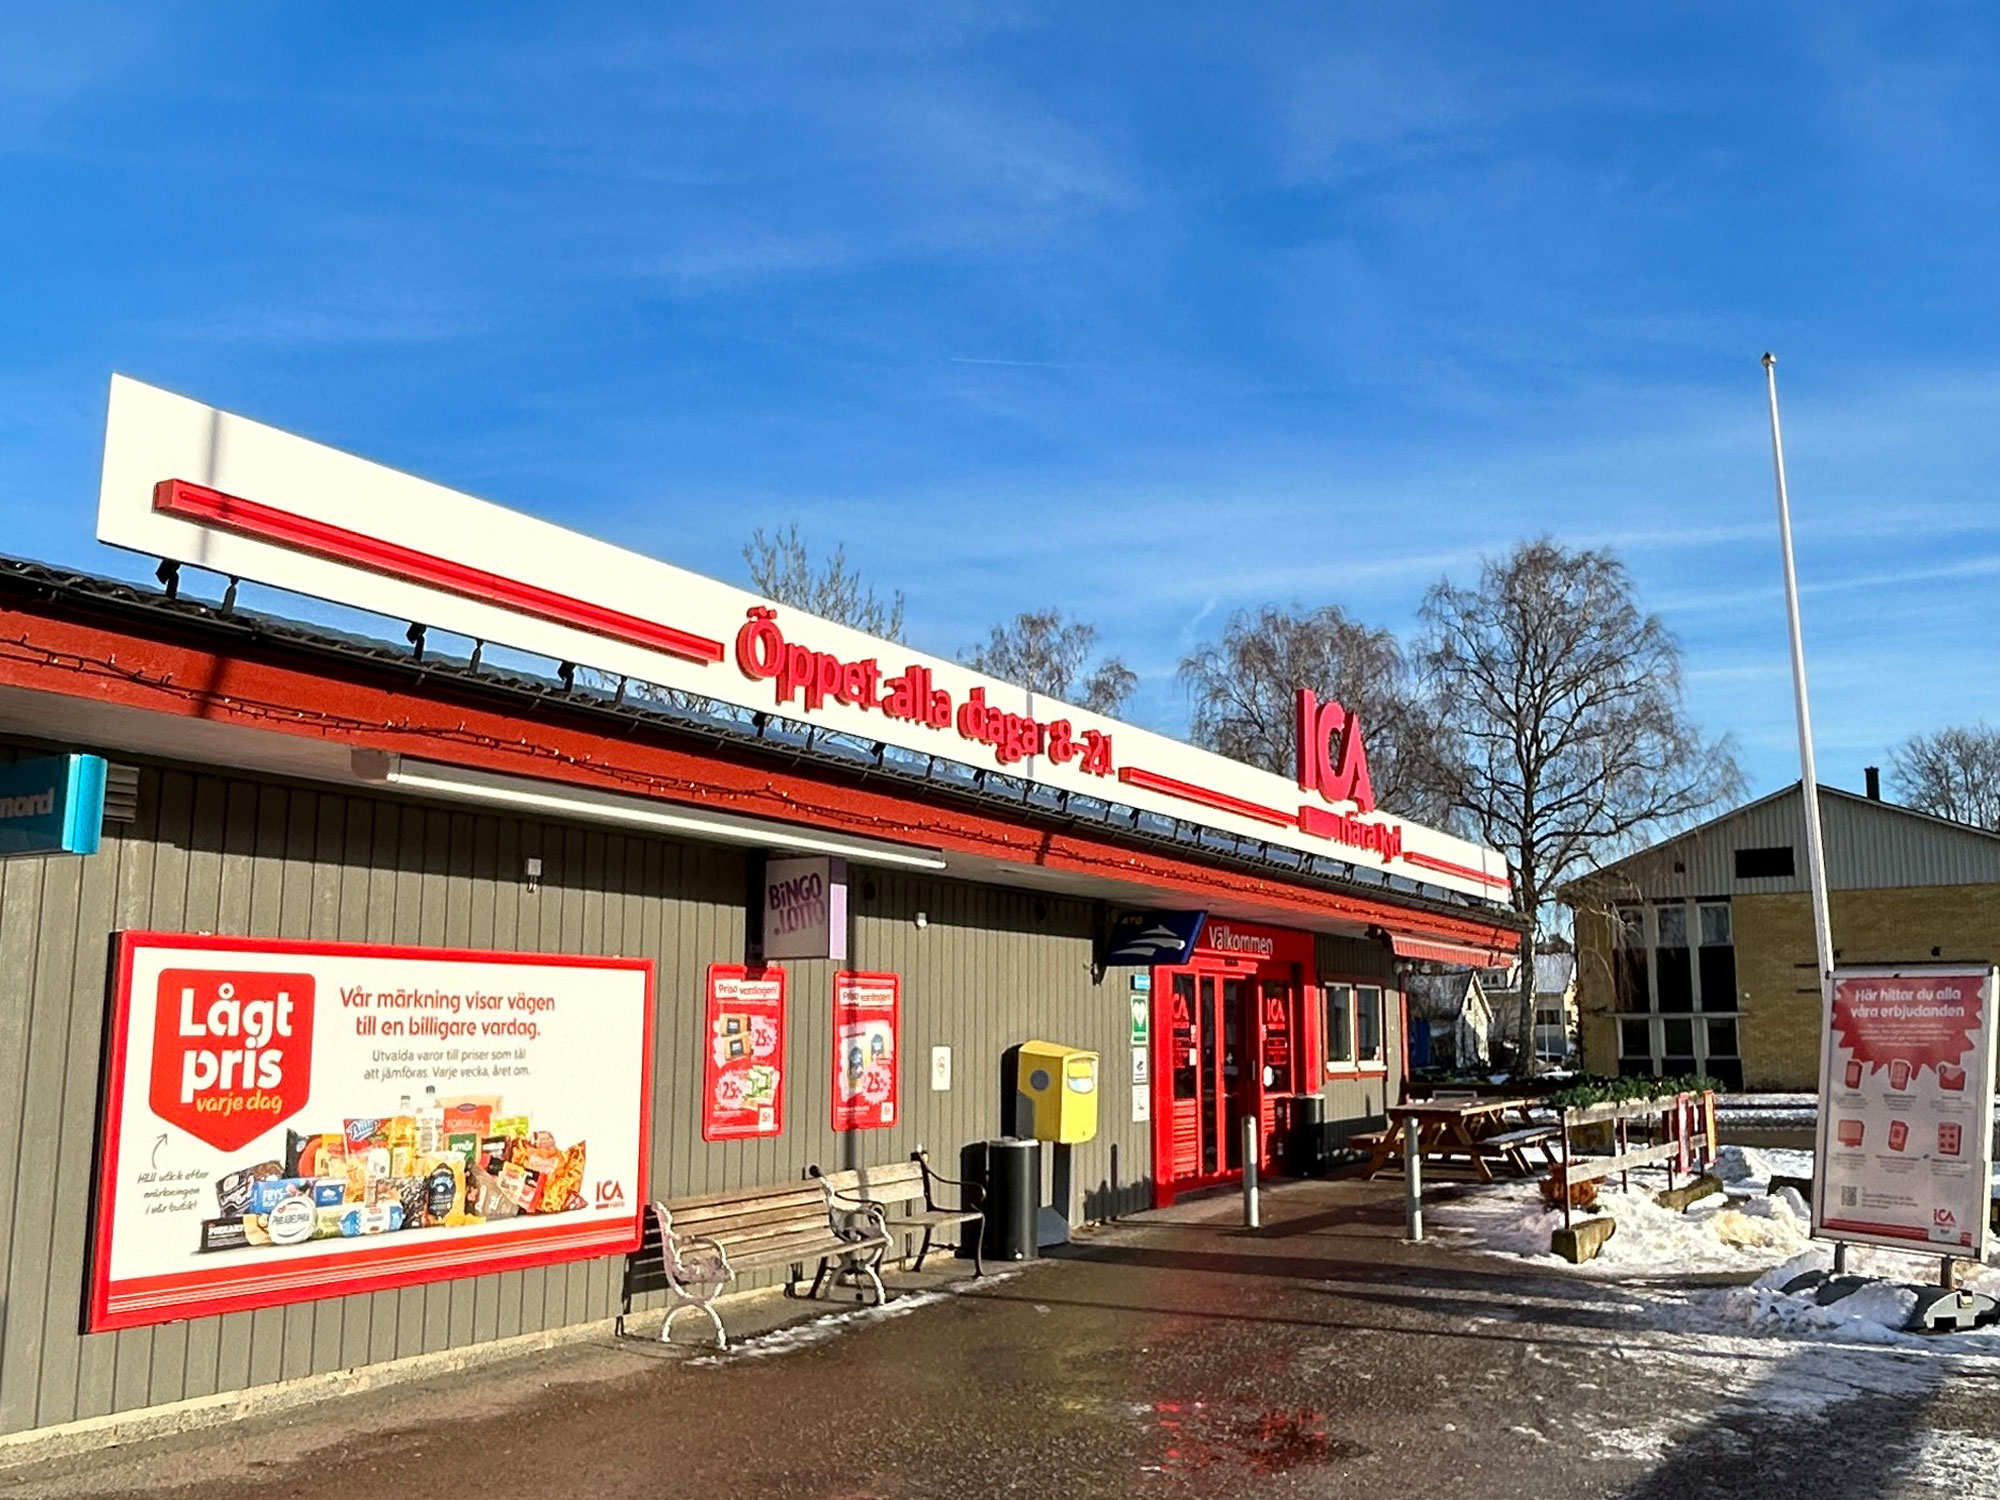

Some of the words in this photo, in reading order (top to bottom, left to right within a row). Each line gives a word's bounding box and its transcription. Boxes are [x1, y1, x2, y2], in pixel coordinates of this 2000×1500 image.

[736, 606, 882, 713] Öppet
[883, 664, 952, 730] alla
[957, 687, 1049, 763] dagar
[1049, 718, 1115, 777] 8-21
[1296, 687, 1374, 813] ICA
[1121, 915, 1144, 926] ATG
[1209, 925, 1274, 956] Välkommen
[339, 985, 373, 1009] Vår
[376, 988, 461, 1014] märkning
[465, 990, 504, 1011] visar
[506, 991, 556, 1015] vägen
[1855, 988, 1878, 1002] Här
[1880, 987, 1914, 1002] hittar
[1917, 987, 1934, 1001] du
[1936, 986, 1962, 1001] alla
[178, 982, 294, 1050] Lågt
[1267, 998, 1286, 1022] ICA
[1850, 1004, 1879, 1019] våra
[1880, 1003, 1965, 1020] erbjudanden
[355, 1015, 377, 1036] till
[380, 1019, 405, 1036] en
[408, 1015, 477, 1040] billigare
[481, 1017, 542, 1041] vardag.
[371, 1049, 415, 1062] Utvalda
[417, 1051, 444, 1061] varor
[446, 1048, 460, 1060] till
[460, 1050, 490, 1063] priser
[491, 1050, 512, 1060] som
[514, 1047, 527, 1060] tål
[180, 1036, 284, 1104] pris
[363, 1067, 380, 1080] att
[381, 1066, 429, 1082] jämföras.
[432, 1066, 458, 1080] Varje
[491, 1063, 512, 1077] året
[196, 1092, 243, 1117] varje
[246, 1089, 284, 1115] dag
[596, 1180, 624, 1202] ICA
[1933, 1208, 1956, 1224] ICA
